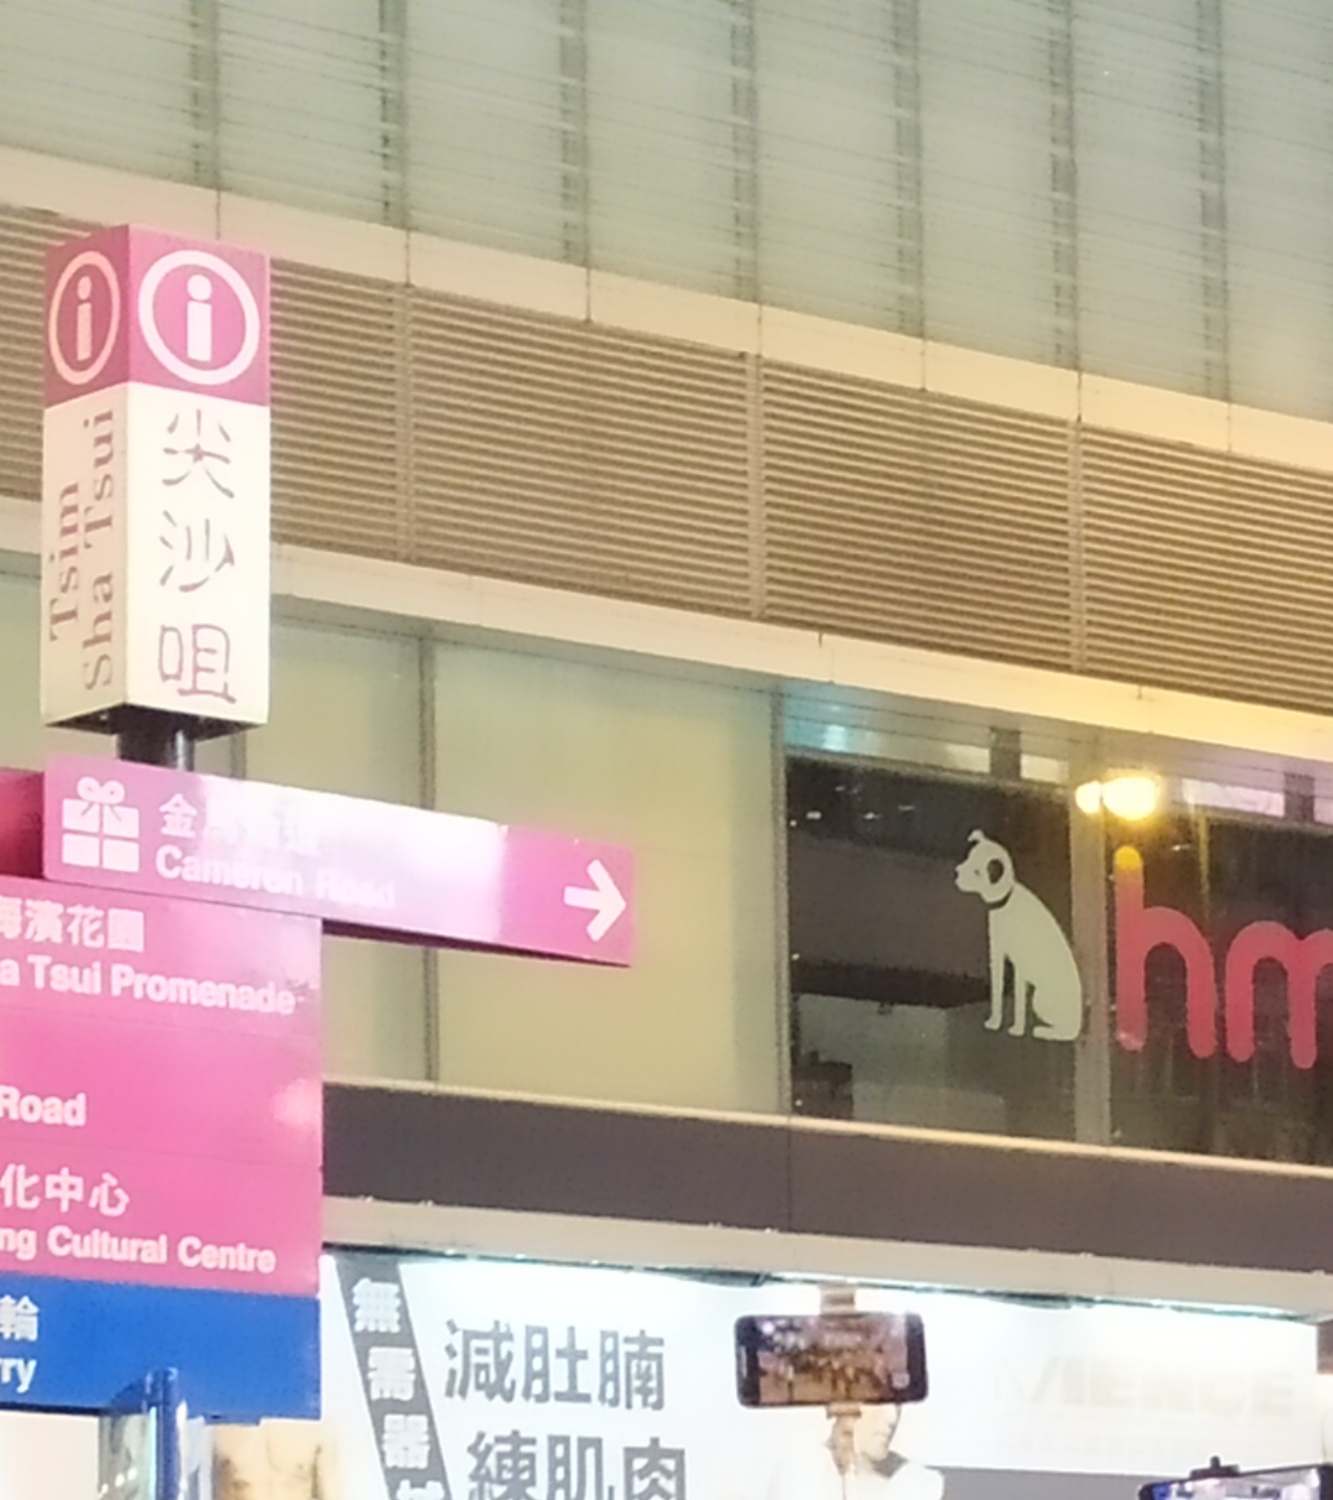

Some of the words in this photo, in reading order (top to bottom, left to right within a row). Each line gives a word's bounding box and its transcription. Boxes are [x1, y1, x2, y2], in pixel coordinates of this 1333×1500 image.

[84, 408, 115, 552] Tsui
[49, 481, 80, 642] Tsim
[157, 408, 237, 704] 尖沙咀
[84, 571, 114, 690] Sha
[156, 844, 304, 895] Cameron
[27, 954, 102, 995] Tsui
[110, 963, 296, 1015] Promenade
[0, 1085, 87, 1127] Road
[0, 1163, 130, 1217] 化中心
[48, 1225, 167, 1265] Cultural
[178, 1237, 277, 1273] Centre
[444, 1319, 666, 1411] 減肚腩
